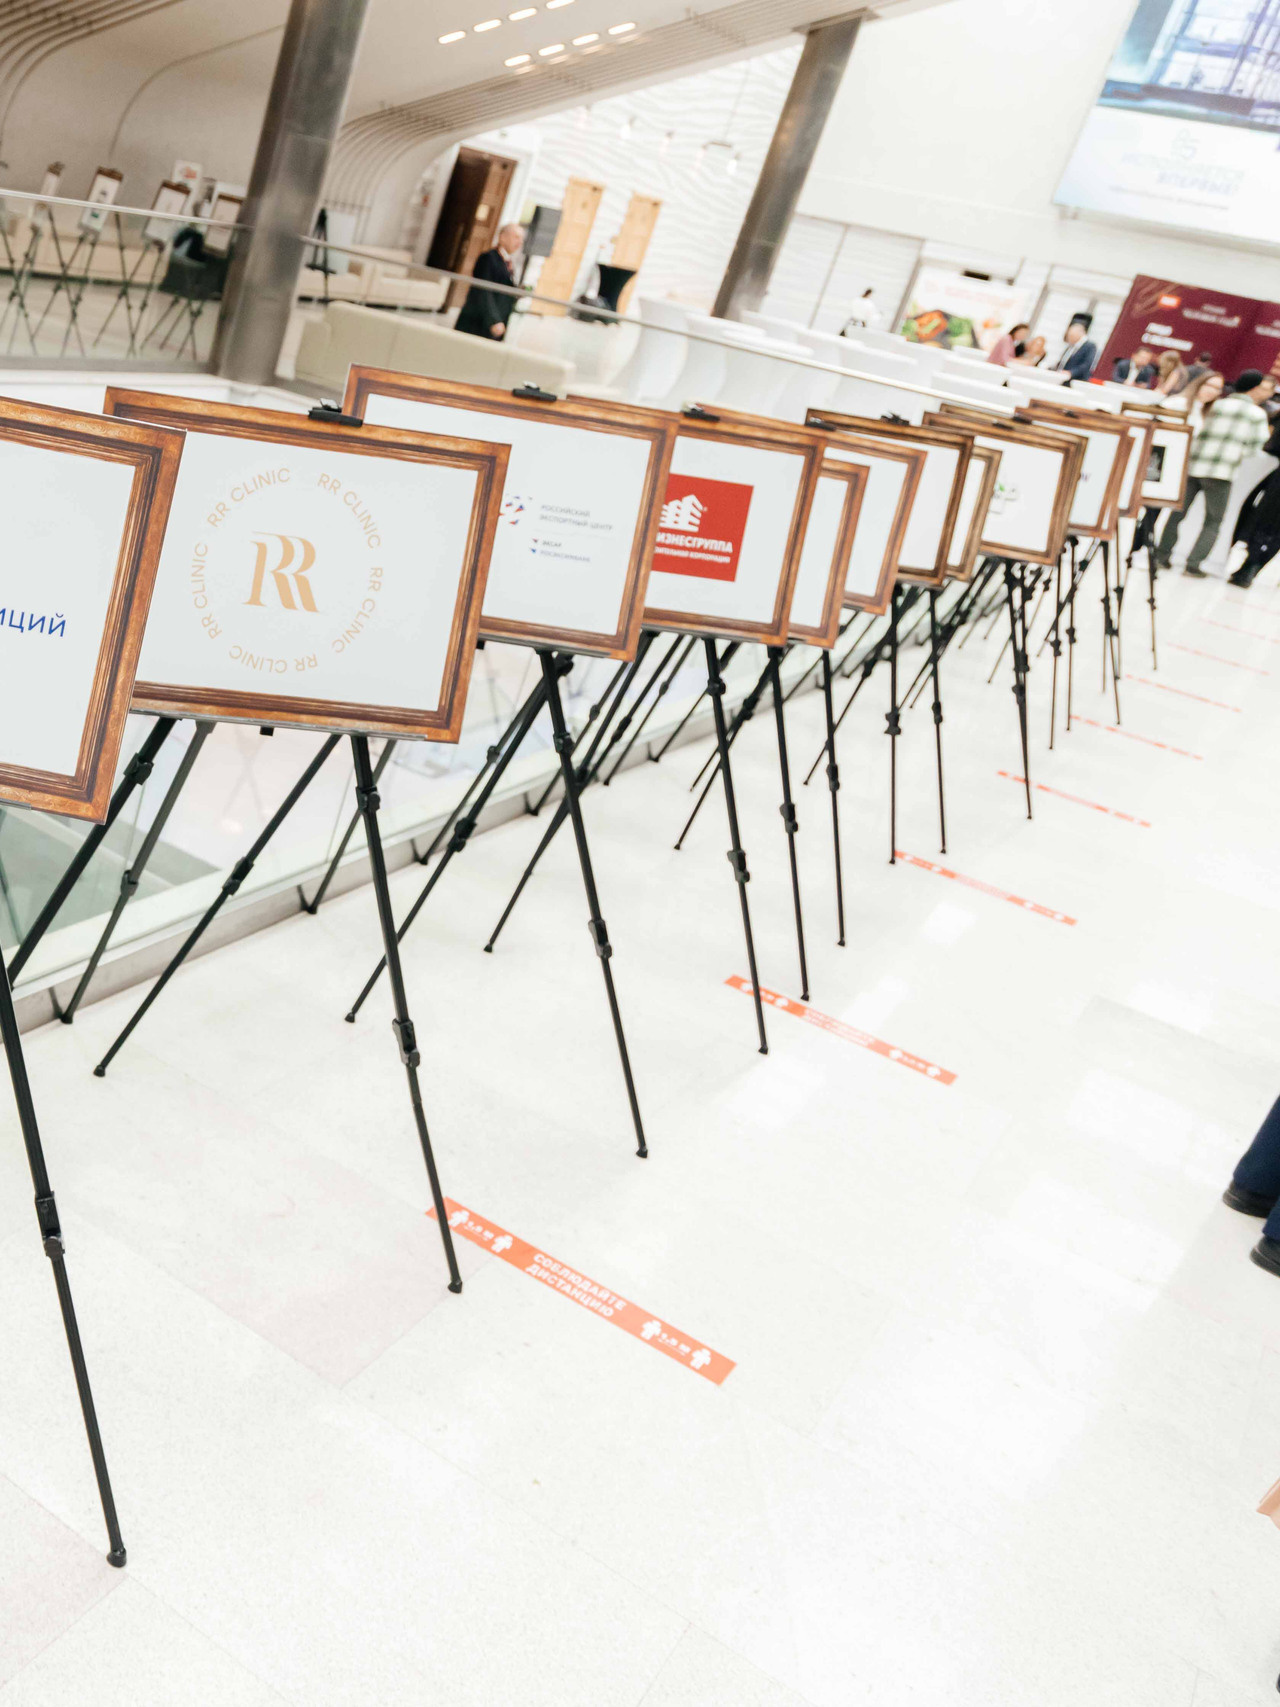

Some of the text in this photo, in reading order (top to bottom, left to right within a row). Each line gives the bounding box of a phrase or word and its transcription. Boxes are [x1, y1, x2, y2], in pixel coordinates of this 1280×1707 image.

[207, 468, 291, 527] RR CLINIC
[317, 473, 381, 549] RR CLINIC
[656, 532, 733, 553] ИЗНЕСГРУППА
[191, 542, 222, 639] RR CLINIC
[331, 567, 384, 654] RR CLINIC
[228, 644, 318, 673] RR CLINIC
[525, 1264, 615, 1317] ДИСТАНЦИЮ
[533, 1253, 626, 1311] СОБЛЮДАЙТЕ
